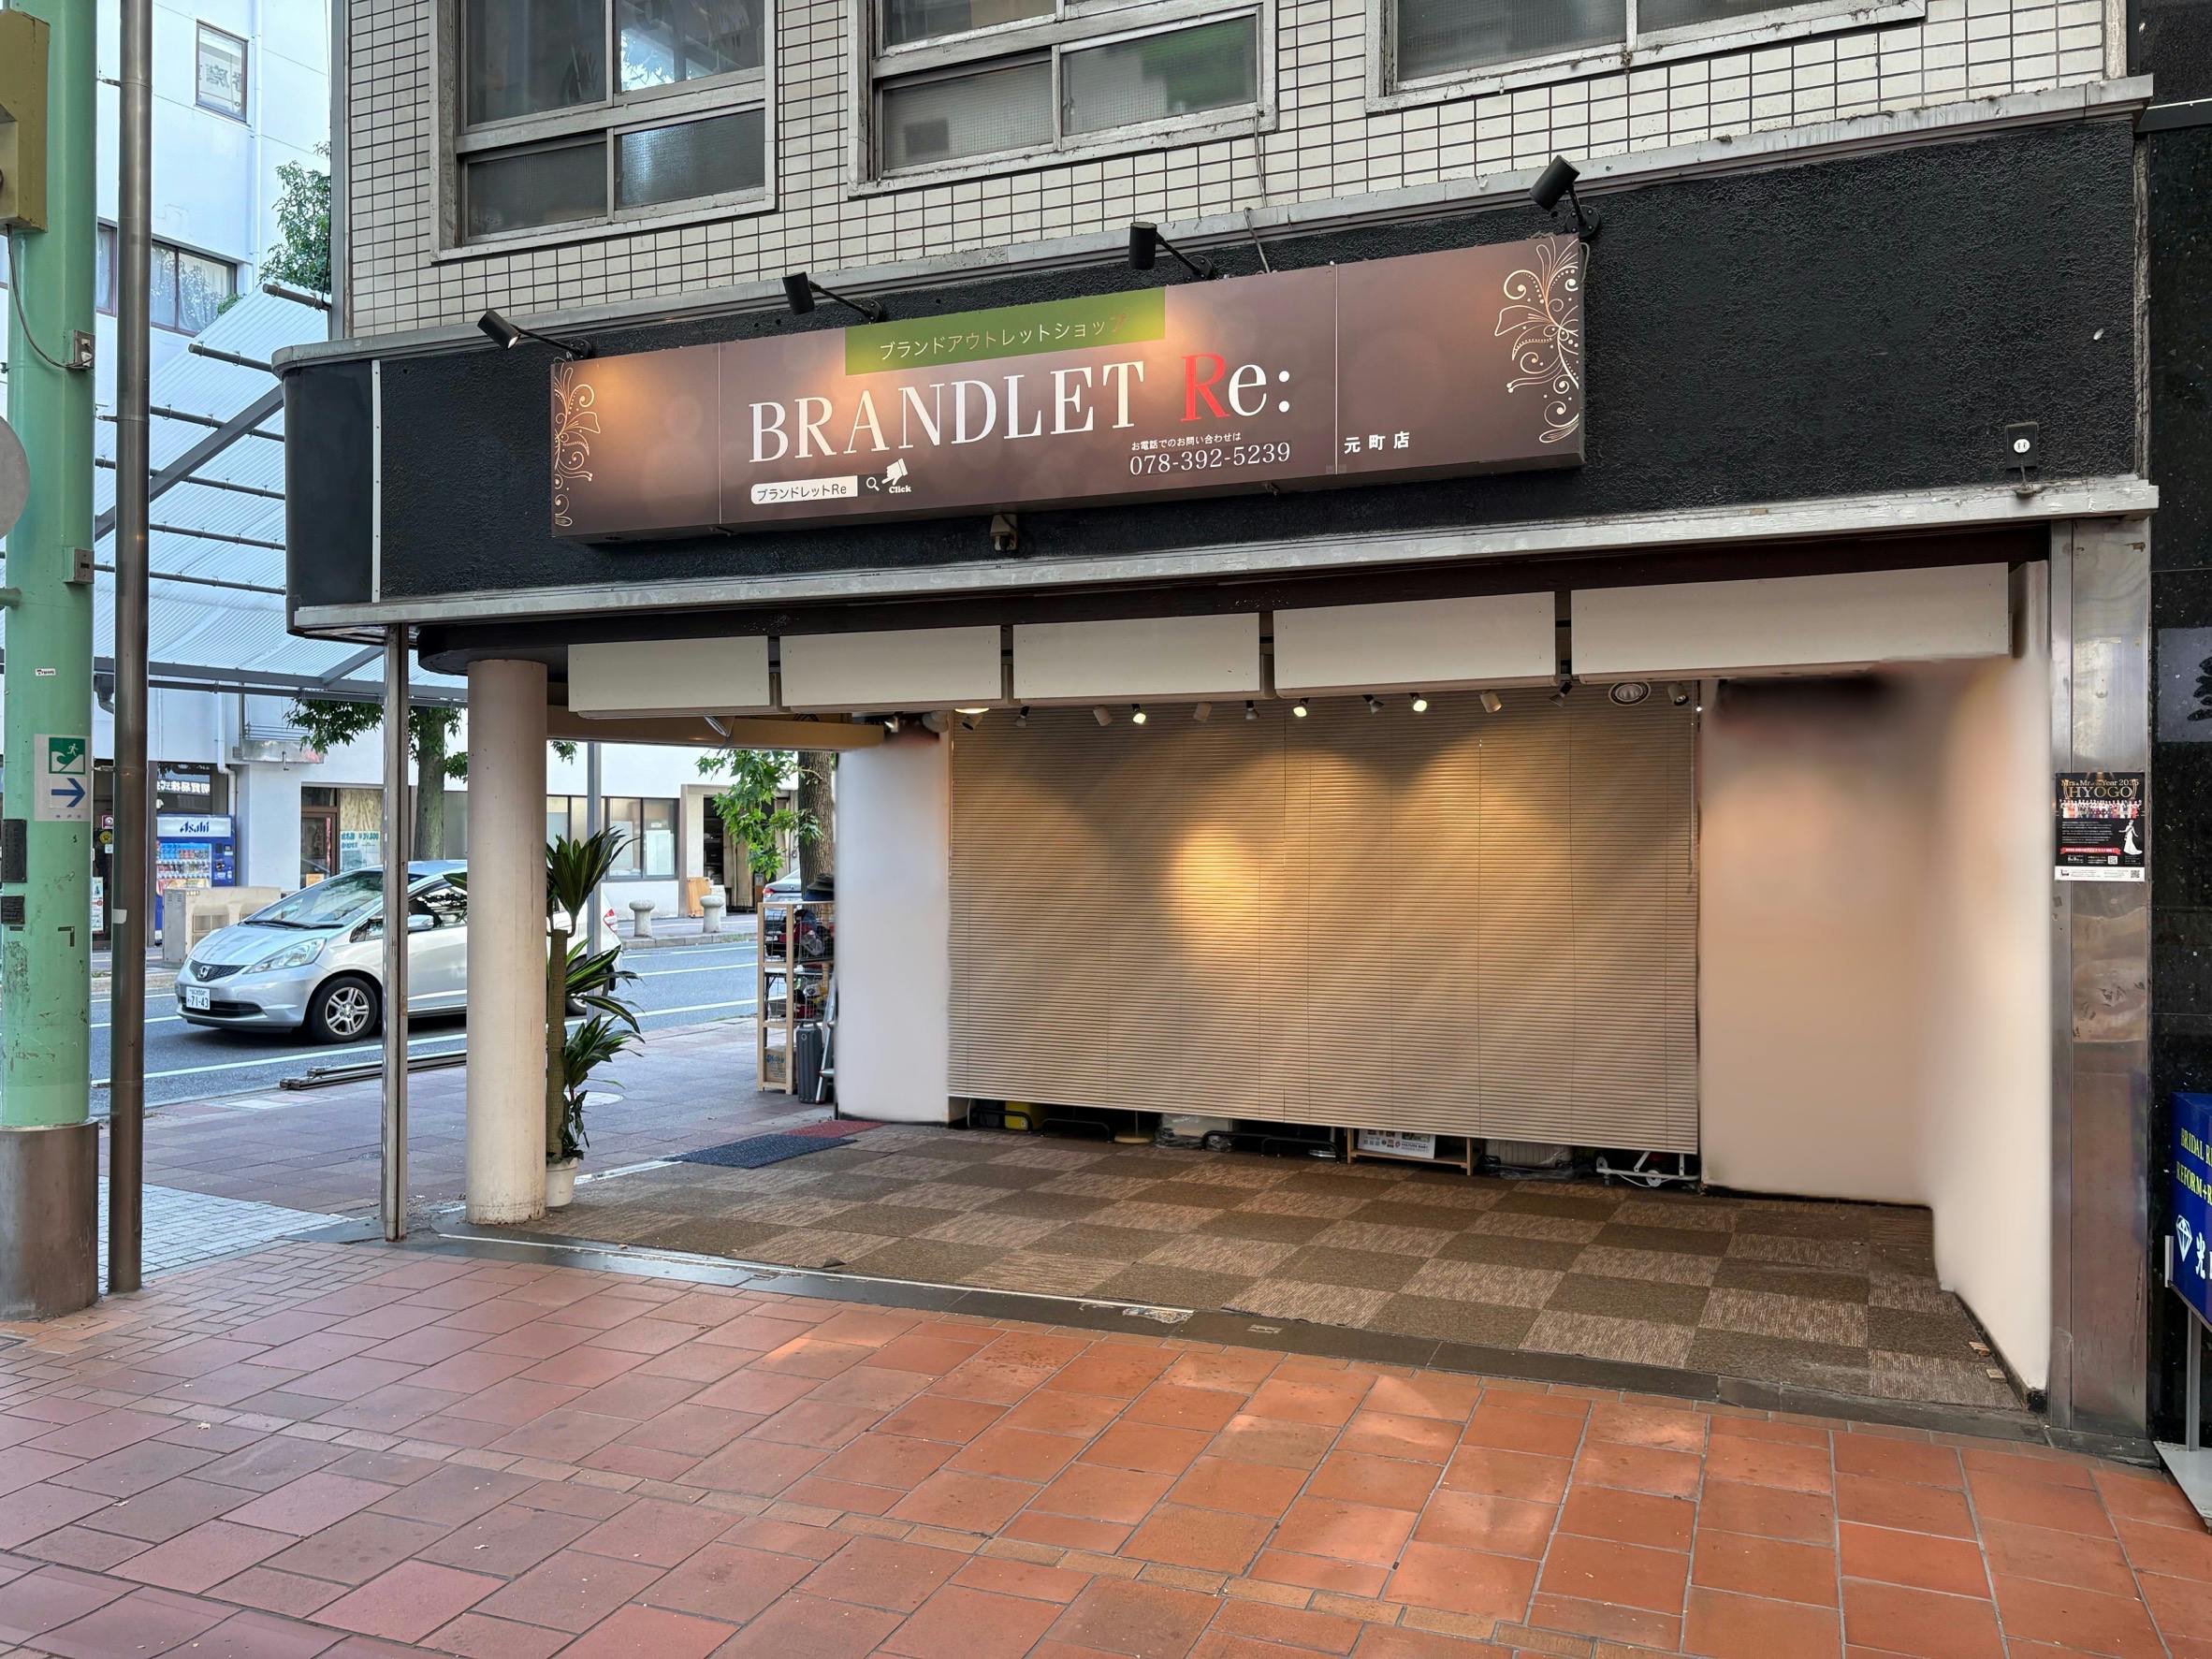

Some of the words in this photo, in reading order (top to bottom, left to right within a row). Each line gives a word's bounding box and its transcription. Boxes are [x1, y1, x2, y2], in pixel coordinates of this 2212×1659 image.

[880, 313, 1127, 360] ブランドアウトレットショップ
[748, 360, 1144, 464] BRANDLET
[1130, 431, 1242, 451] お電話でのお問い合わせは
[1344, 431, 1411, 456] 元町店
[1128, 442, 1290, 475] 078-392-5239
[757, 483, 847, 502] ブランドレットRe
[888, 485, 912, 494] Click
[2067, 786, 2132, 798] HYOGO
[180, 821, 210, 834] Asahi
[2180, 1127, 2205, 1161] BRIDAL
